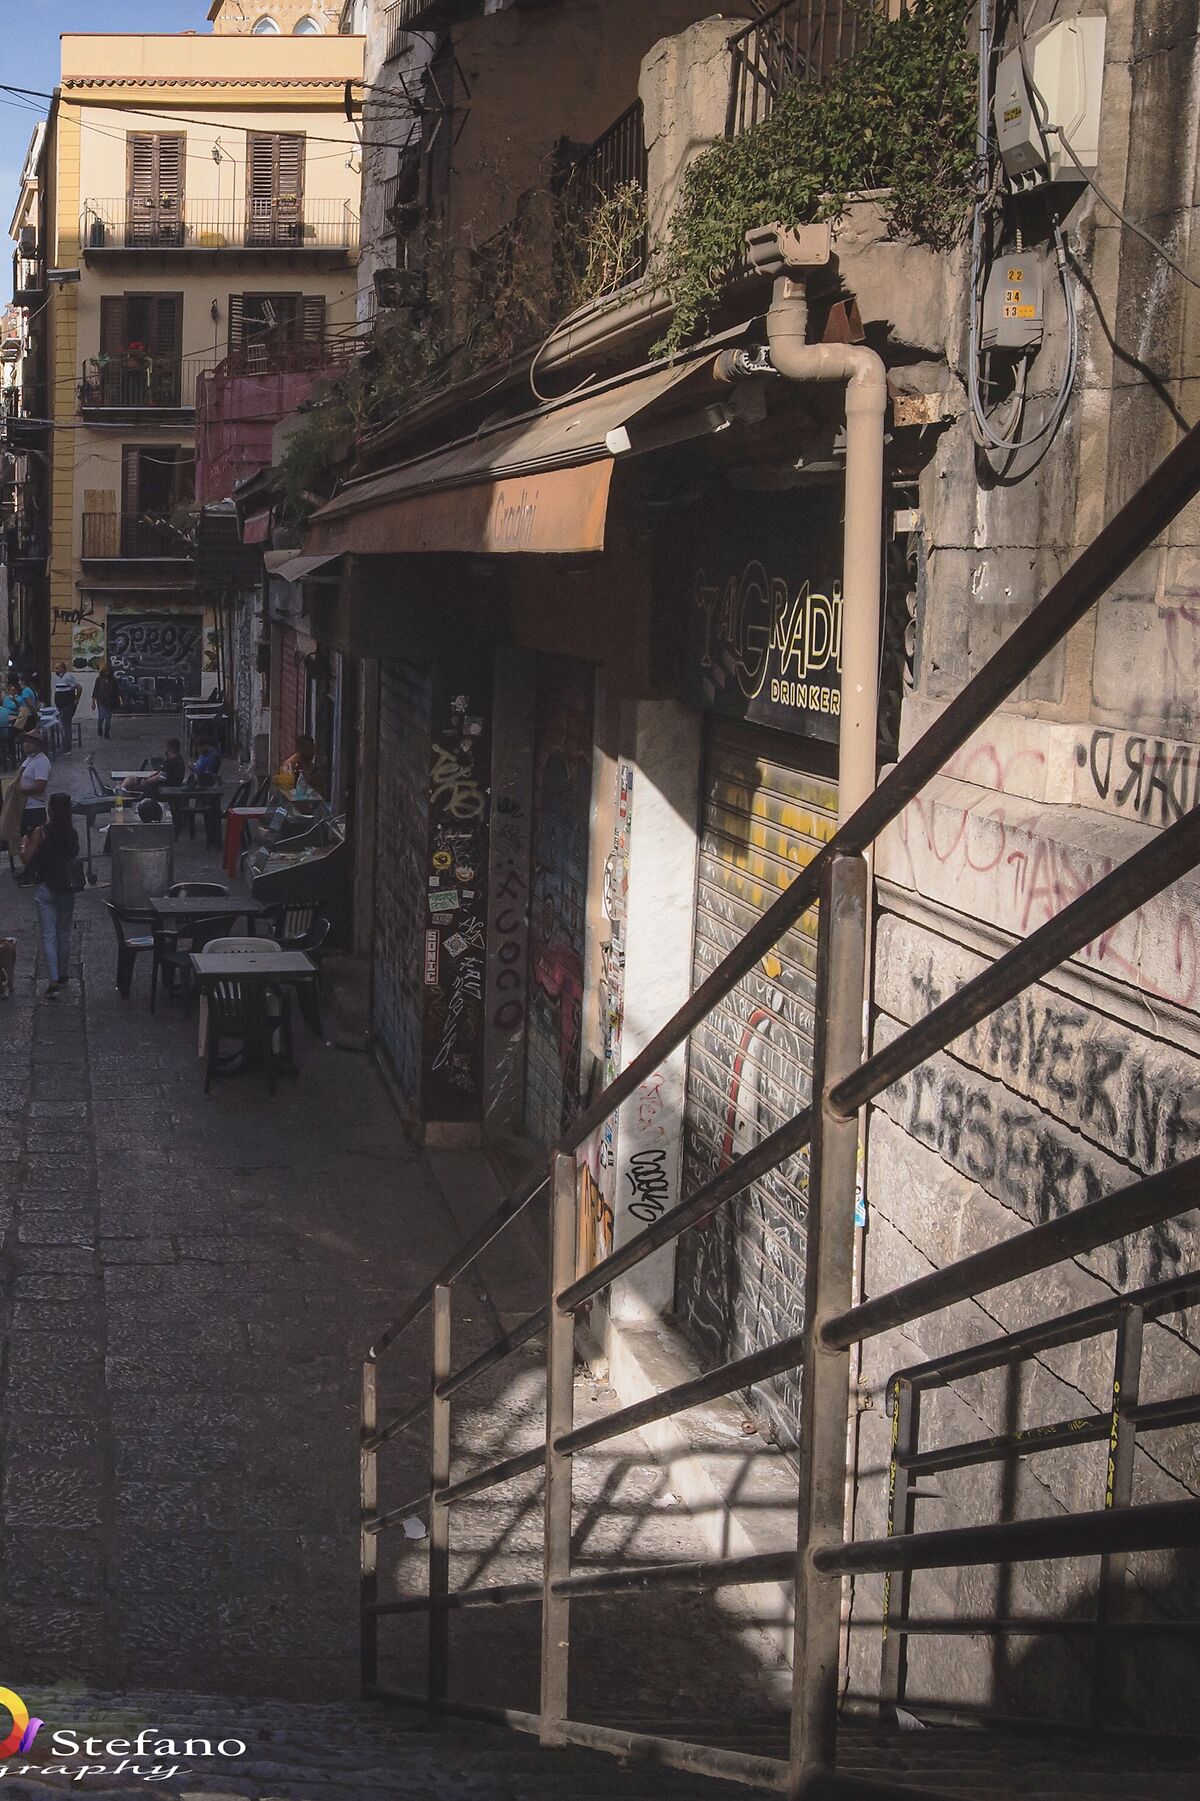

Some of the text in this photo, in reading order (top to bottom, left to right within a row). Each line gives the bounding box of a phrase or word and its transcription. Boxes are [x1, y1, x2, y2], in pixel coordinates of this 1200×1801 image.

[1009, 270, 1022, 280] 22
[1006, 291, 1019, 301] 34
[1005, 306, 1017, 316] 13
[735, 560, 843, 699] GRADi
[771, 678, 841, 716] DRINKER
